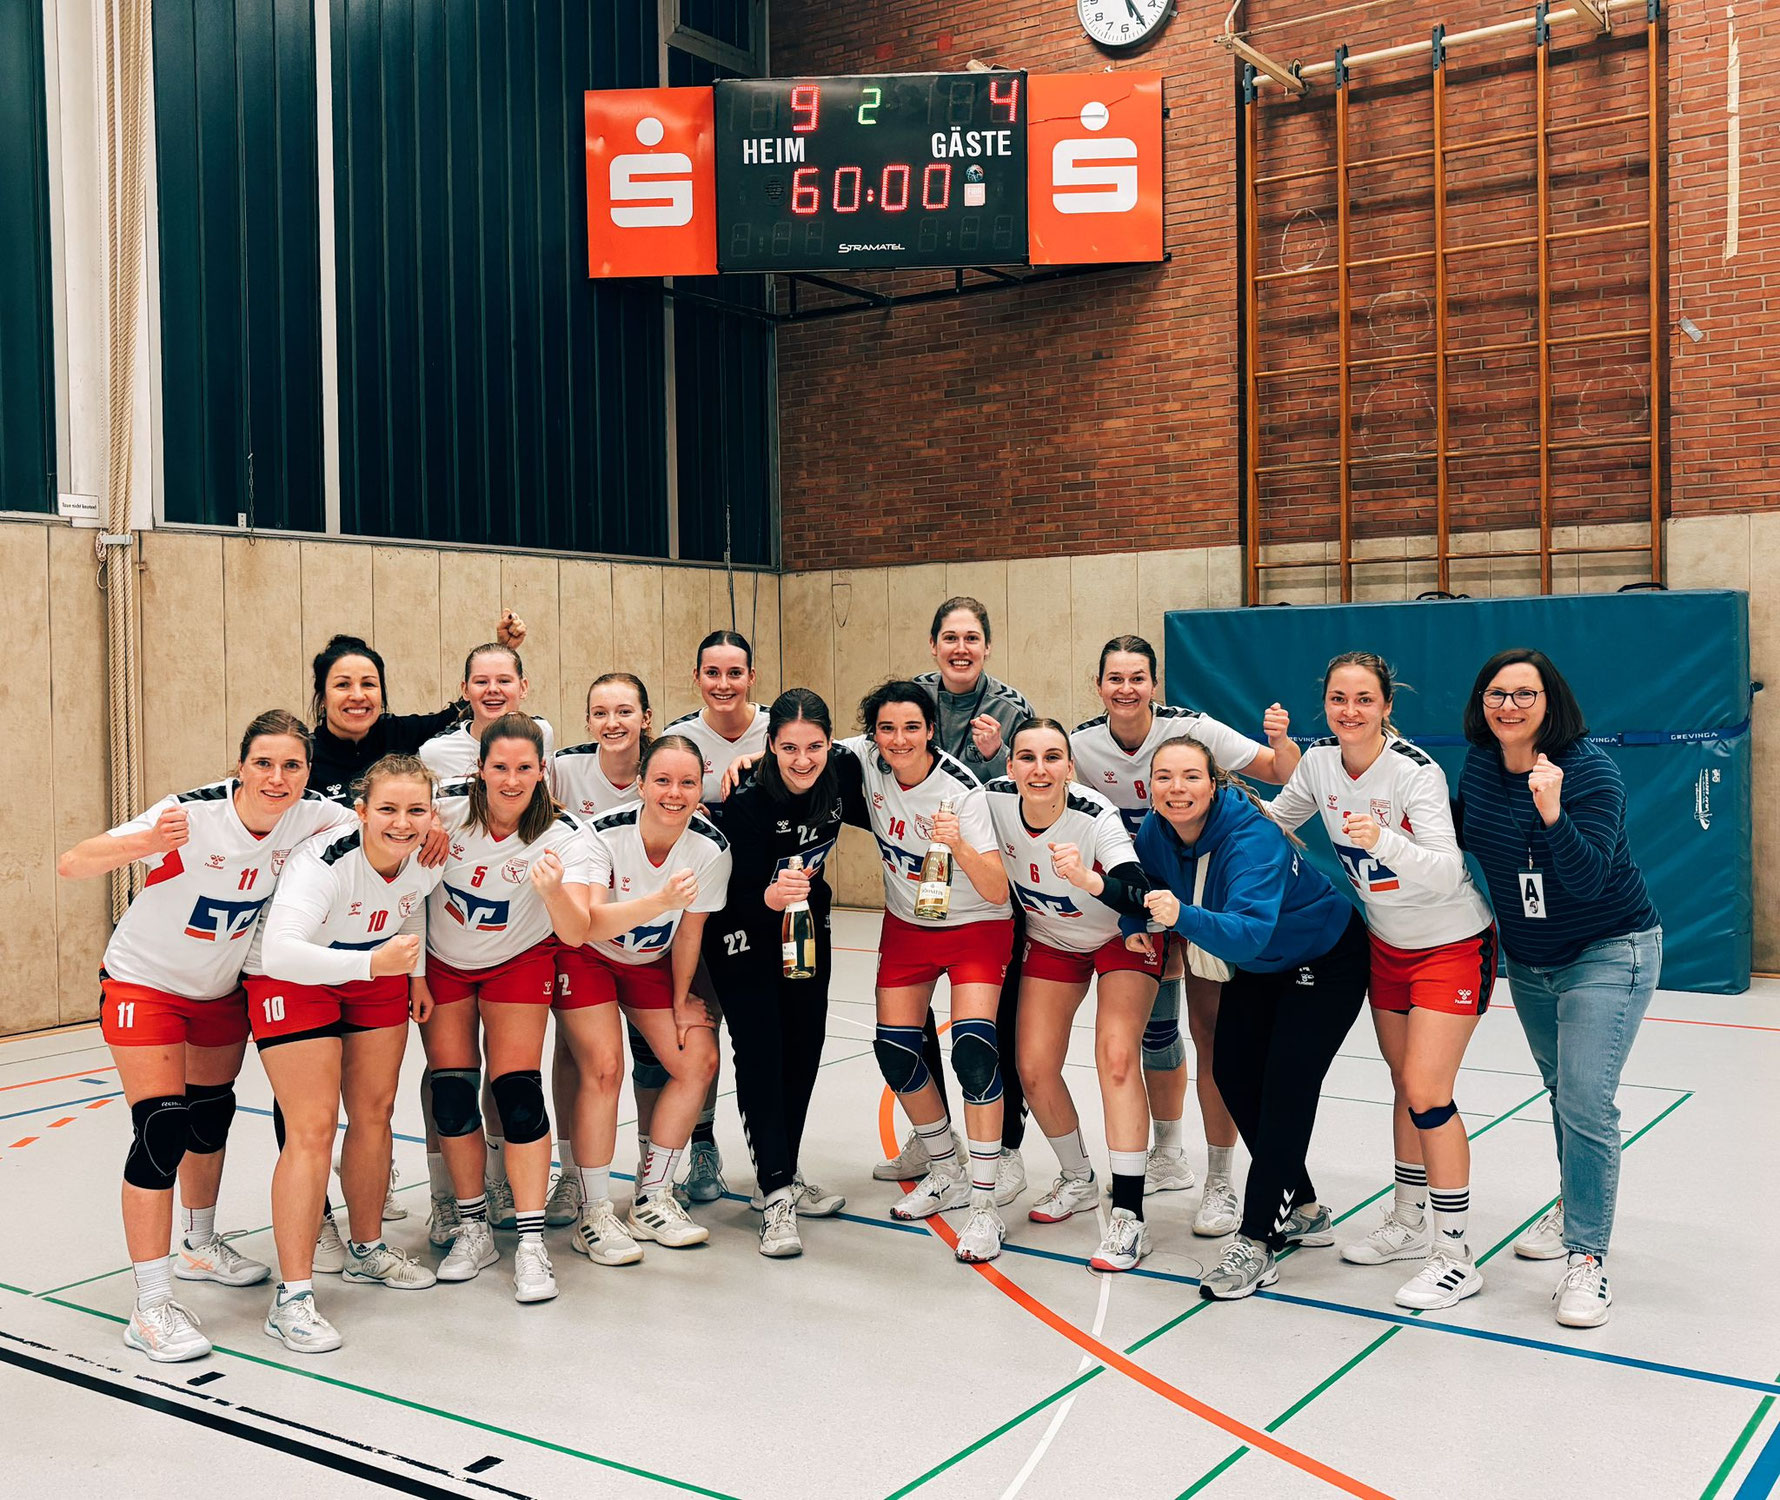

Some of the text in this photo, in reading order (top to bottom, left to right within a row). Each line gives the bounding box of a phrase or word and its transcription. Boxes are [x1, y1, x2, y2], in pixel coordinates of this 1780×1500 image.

[1095, 12, 1104, 21] 8
[1106, 21, 1114, 31] 7
[1120, 23, 1130, 33] 6
[791, 85, 820, 132] 9
[858, 88, 881, 125] 2
[989, 78, 1019, 122] 4
[743, 137, 805, 164] HEIM
[931, 126, 1012, 158] GÄSTE
[791, 164, 952, 214] 60:00
[1670, 731, 1719, 741] GREVINGA
[1133, 780, 1147, 799] 8
[888, 816, 906, 841] 14
[237, 868, 259, 891] 11
[470, 865, 489, 888] 5
[1029, 863, 1040, 884] 6
[1524, 878, 1540, 901] A
[367, 909, 389, 933] 10
[723, 929, 751, 956] 22
[117, 1001, 135, 1028] 11
[262, 995, 286, 1023] 10
